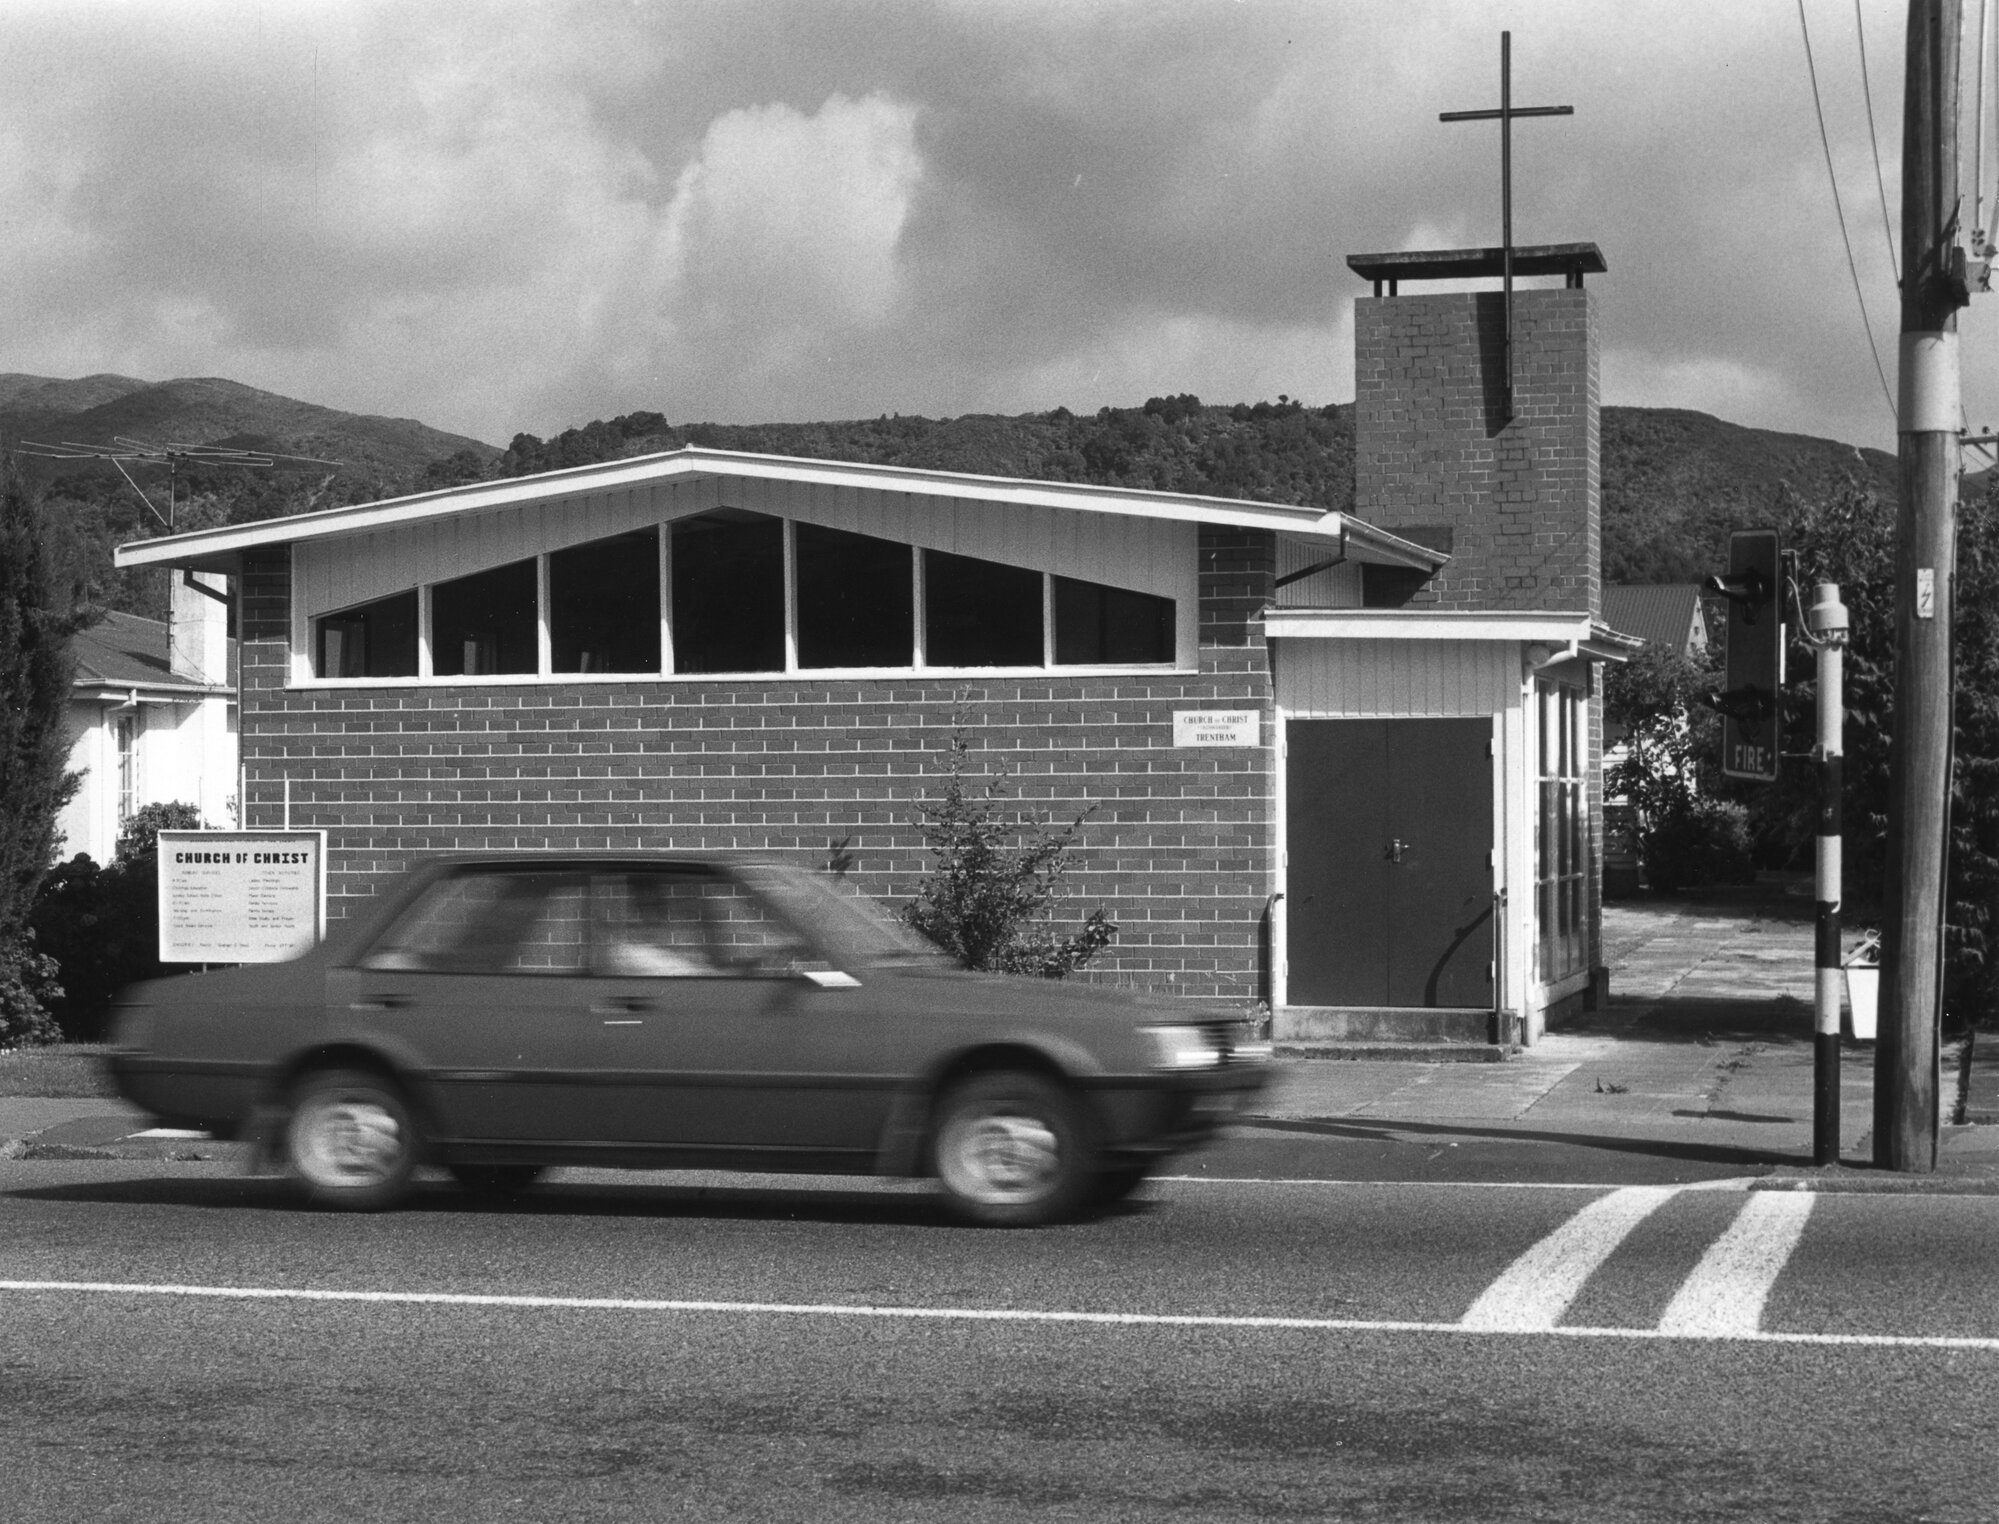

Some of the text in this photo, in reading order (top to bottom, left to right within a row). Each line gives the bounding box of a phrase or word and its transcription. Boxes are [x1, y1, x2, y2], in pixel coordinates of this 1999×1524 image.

[1183, 715, 1213, 724] CHURCH
[1222, 715, 1248, 724] CHRIST
[1196, 733, 1236, 742] TRENTHAM
[1735, 744, 1765, 772] FIRE
[175, 852, 309, 864] CHURCH OF CHRIST
